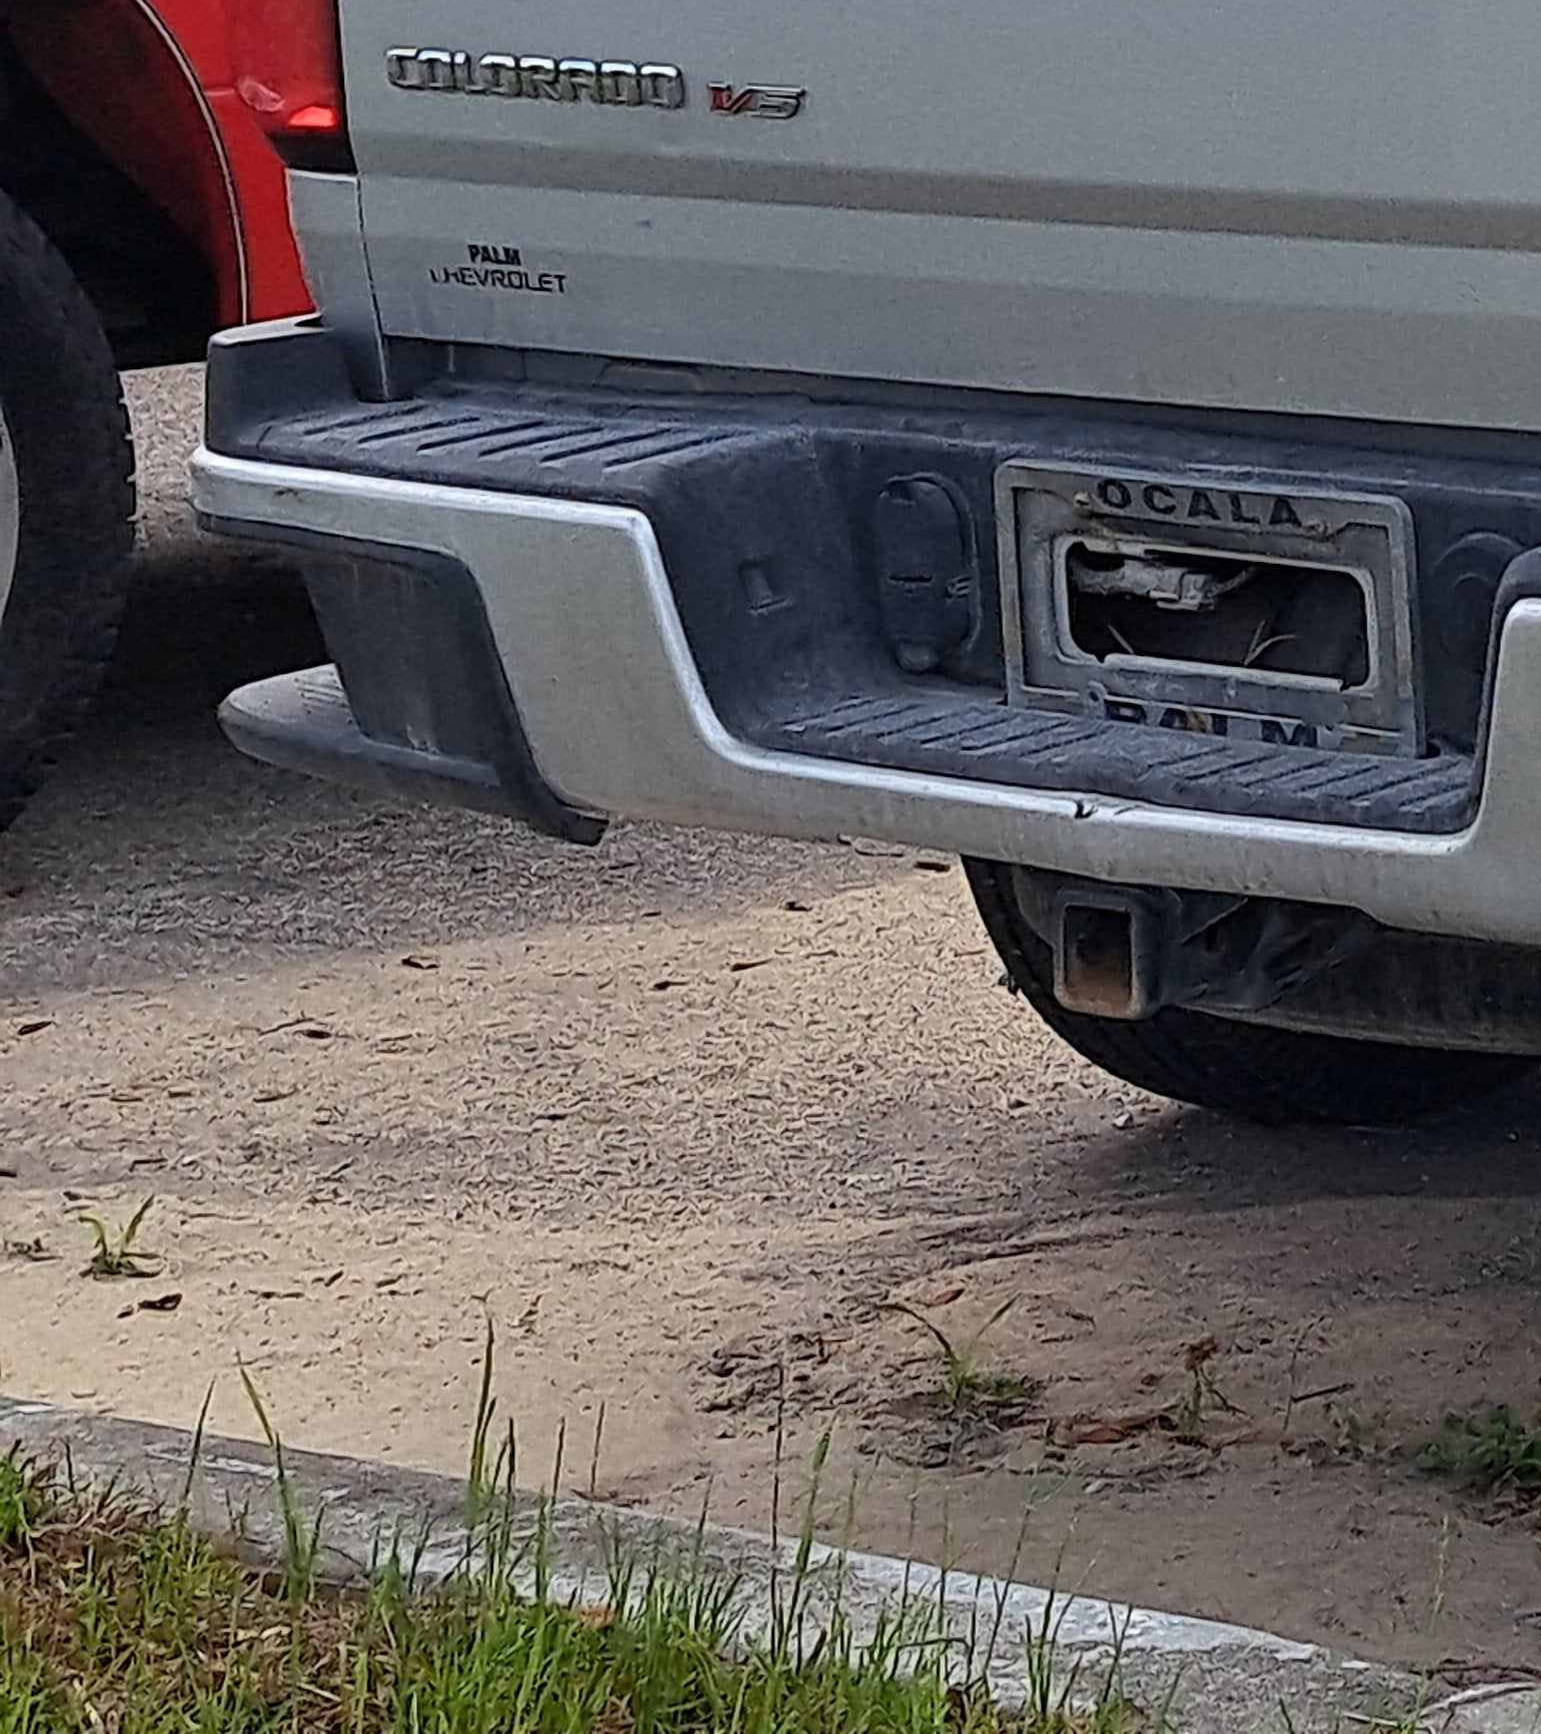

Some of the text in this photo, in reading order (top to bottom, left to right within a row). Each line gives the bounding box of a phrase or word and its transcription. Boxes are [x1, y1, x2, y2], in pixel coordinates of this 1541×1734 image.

[384, 46, 686, 109] COLORADO
[468, 244, 521, 266] PALM
[1098, 479, 1301, 527] OCALA
